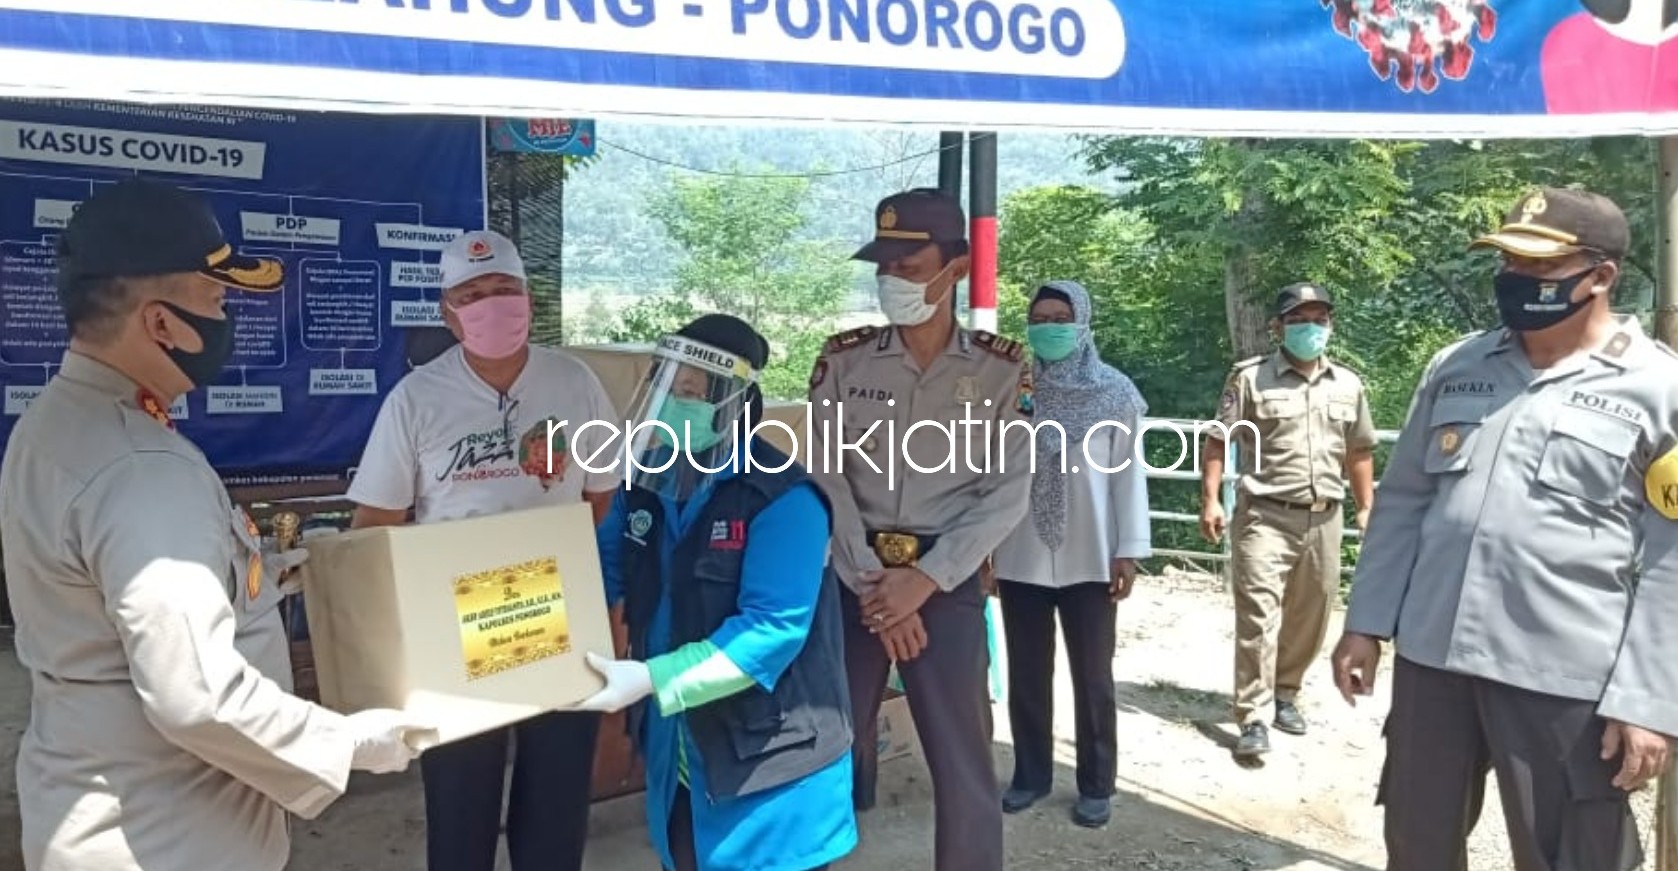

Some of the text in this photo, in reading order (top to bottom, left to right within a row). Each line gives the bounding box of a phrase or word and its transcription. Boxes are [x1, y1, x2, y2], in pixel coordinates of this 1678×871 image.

[730, 0, 1086, 57] PONOROGO
[18, 128, 244, 168] KASUS COVID-19
[276, 217, 307, 230] PDP
[684, 344, 734, 368] SHIELD
[1570, 390, 1644, 422] POLISI
